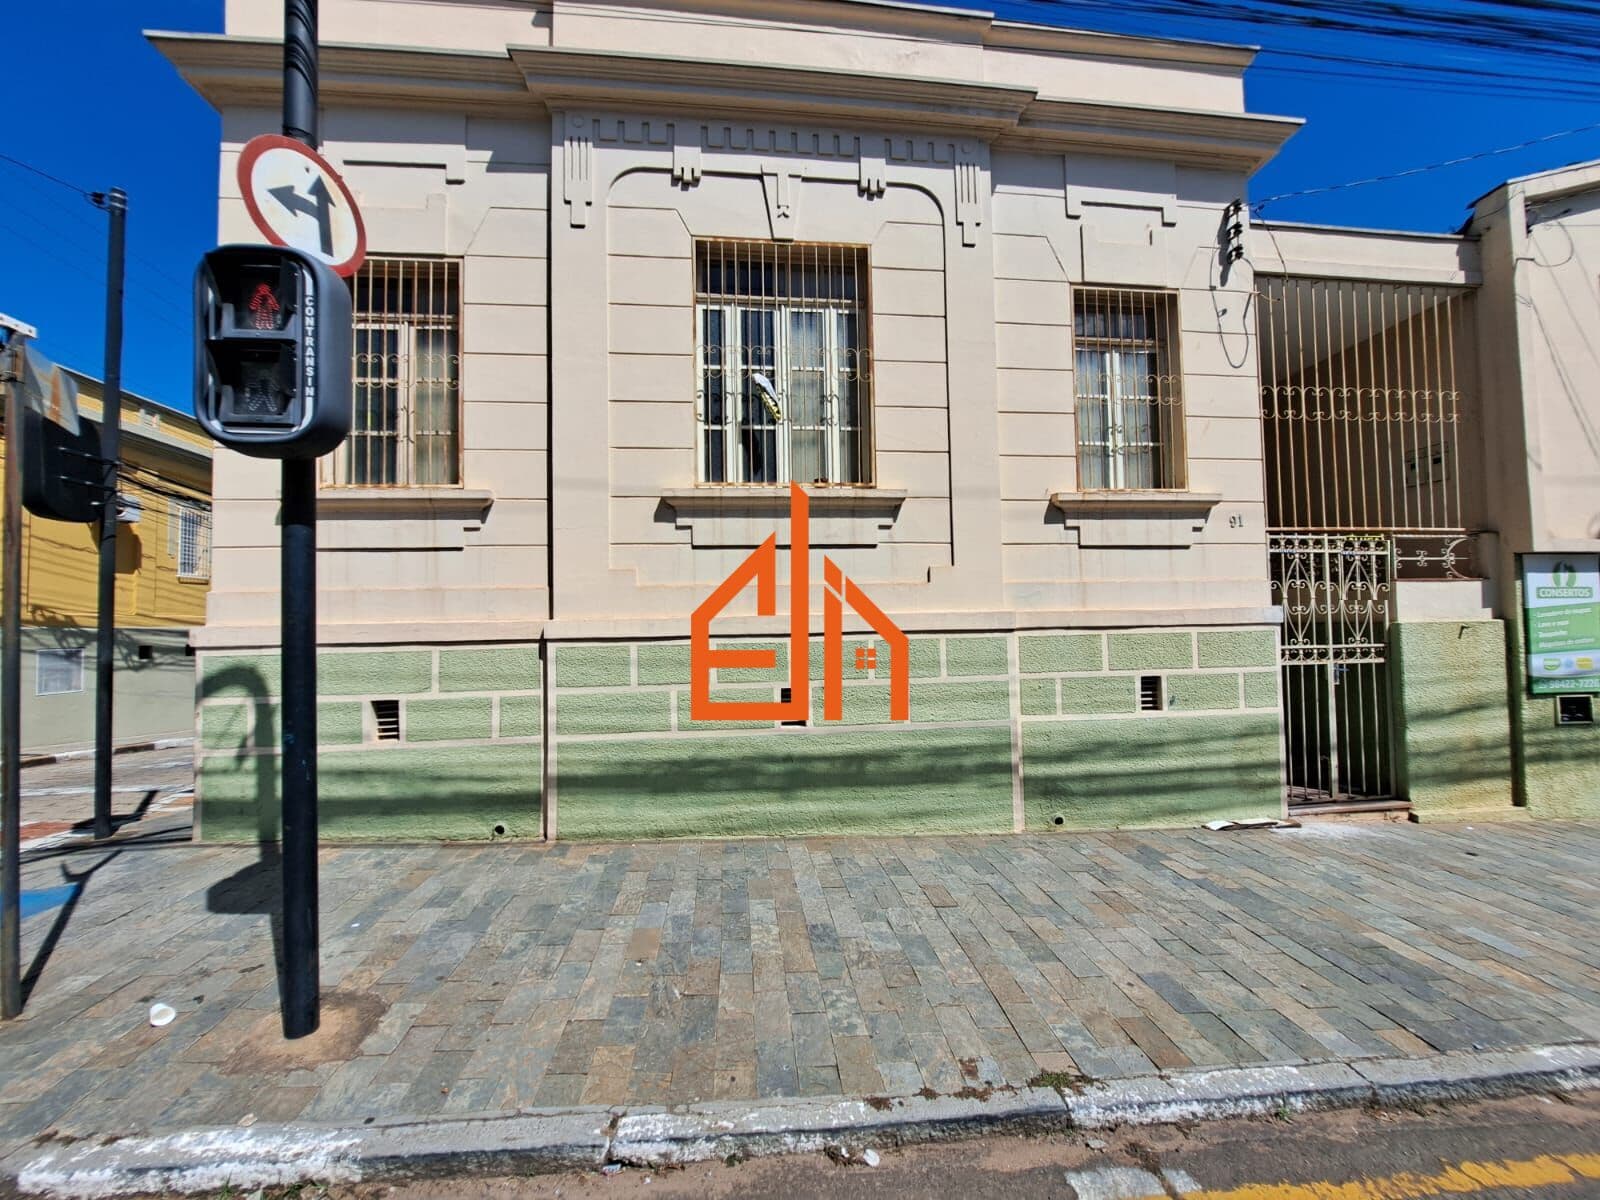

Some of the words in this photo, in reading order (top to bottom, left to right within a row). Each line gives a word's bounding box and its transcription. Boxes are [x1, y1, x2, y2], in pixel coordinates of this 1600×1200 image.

[304, 297, 315, 397] CONTRANSIN
[1229, 514, 1244, 528] 91
[1540, 588, 1590, 598] CONSERTOS
